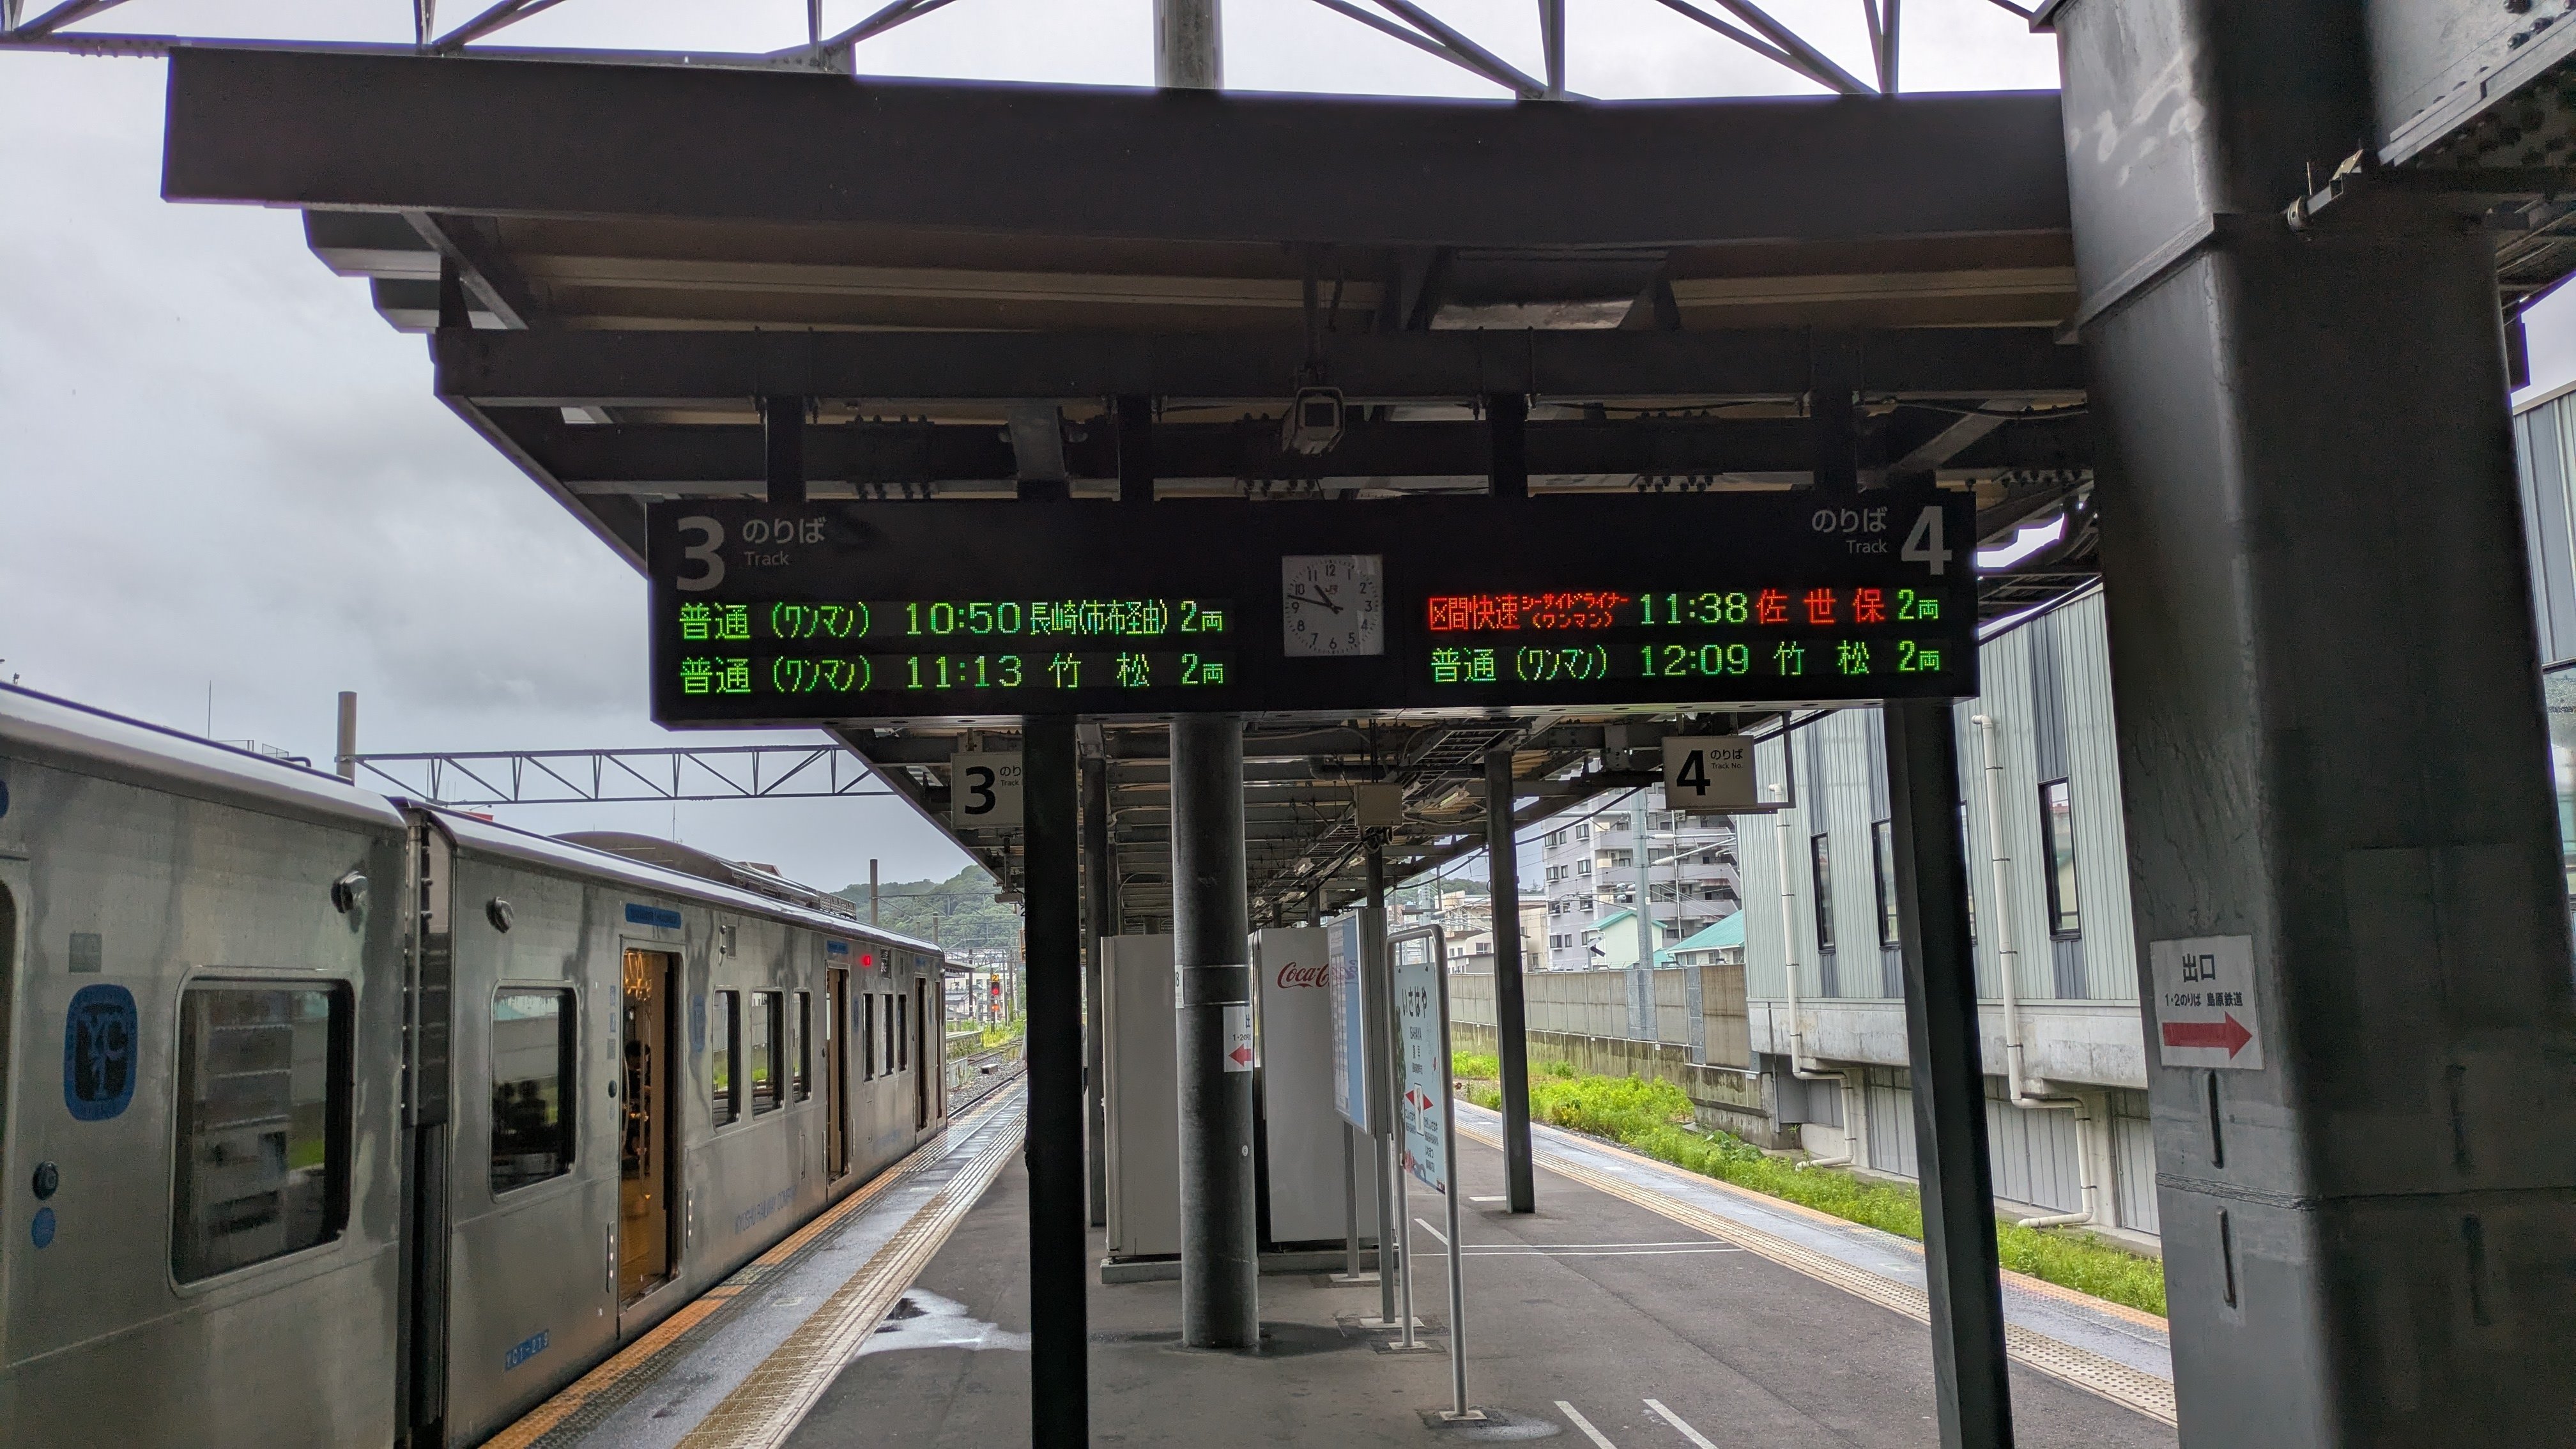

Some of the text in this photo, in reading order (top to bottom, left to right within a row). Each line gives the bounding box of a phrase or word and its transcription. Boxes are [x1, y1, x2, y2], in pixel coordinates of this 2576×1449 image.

[1812, 507, 1888, 533] のりば
[742, 517, 826, 544] のりば
[1845, 539, 1888, 555] Track
[1901, 505, 1952, 576] 4
[676, 516, 726, 592] 3
[744, 550, 790, 567] Track
[1308, 570, 1317, 581] 11
[1325, 564, 1337, 576] 12
[1295, 583, 1305, 595] 10
[1360, 582, 1367, 594] 2
[1291, 602, 1300, 614] 9
[1365, 601, 1372, 612] 3
[1429, 588, 1940, 631] 区間快速 シーサイドライナー 11:38 佐世保 2両
[678, 602, 751, 640] 普通
[907, 602, 1020, 635] 10:50
[1180, 600, 1223, 632] 2両
[1297, 619, 1305, 632] 8
[1361, 618, 1368, 631] 4
[1311, 632, 1319, 645] 7
[1329, 637, 1337, 650] 6
[1348, 631, 1356, 644] 5
[1431, 647, 1497, 682] 普通
[1641, 645, 1749, 676] 12:09
[1899, 640, 1940, 671] 2両
[680, 657, 751, 693] 普通
[907, 655, 1022, 689] 11:13
[1181, 653, 1225, 686] 2両
[1710, 748, 1744, 760] のりば
[999, 765, 1022, 777] のり
[1676, 749, 1711, 796] 4
[964, 765, 996, 815] 3
[2182, 953, 2216, 983] 出口
[1402, 986, 1428, 1019] いさはや
[2207, 992, 2244, 1007] 島原鉄道
